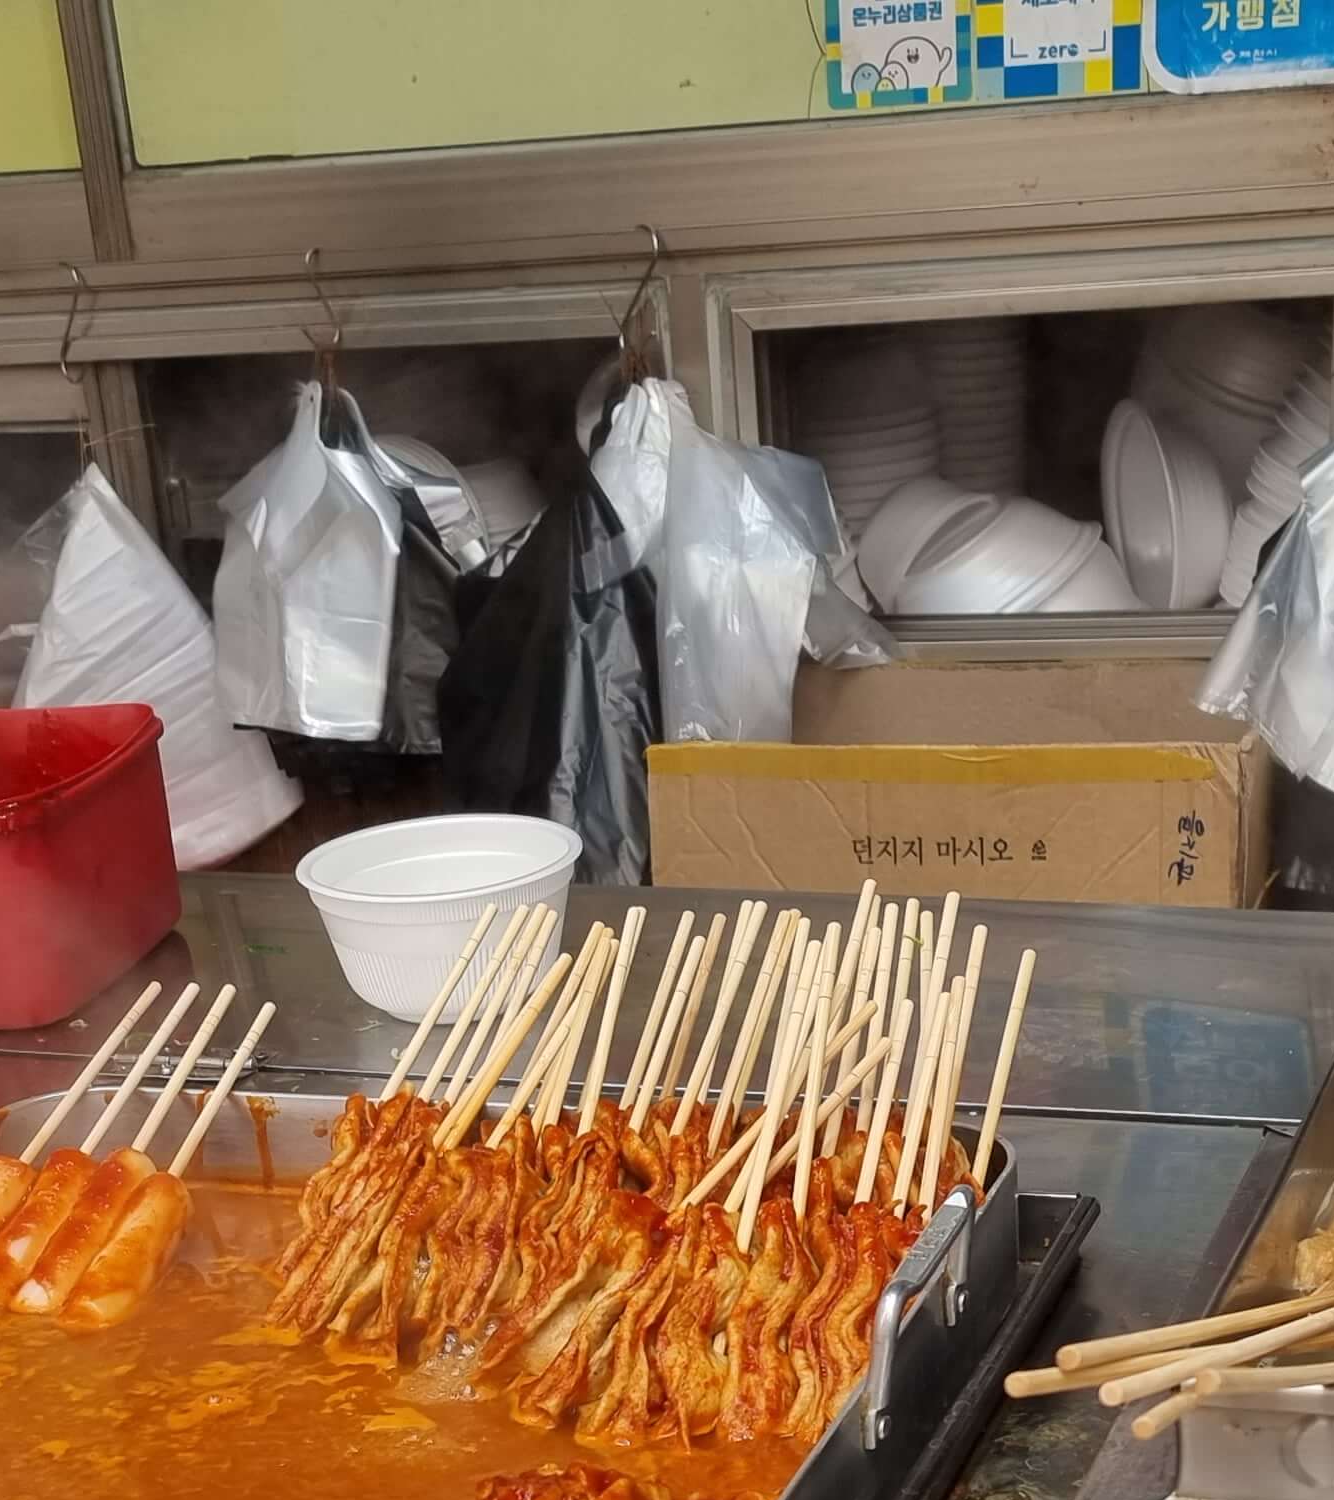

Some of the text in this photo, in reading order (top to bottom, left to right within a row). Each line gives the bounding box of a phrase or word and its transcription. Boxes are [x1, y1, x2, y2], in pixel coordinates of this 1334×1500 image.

[852, 1, 943, 27] 온누리상품권
[1201, 0, 1301, 32] 가맹점
[1037, 42, 1080, 60] zero
[851, 835, 1014, 868] 던지지 마시오
